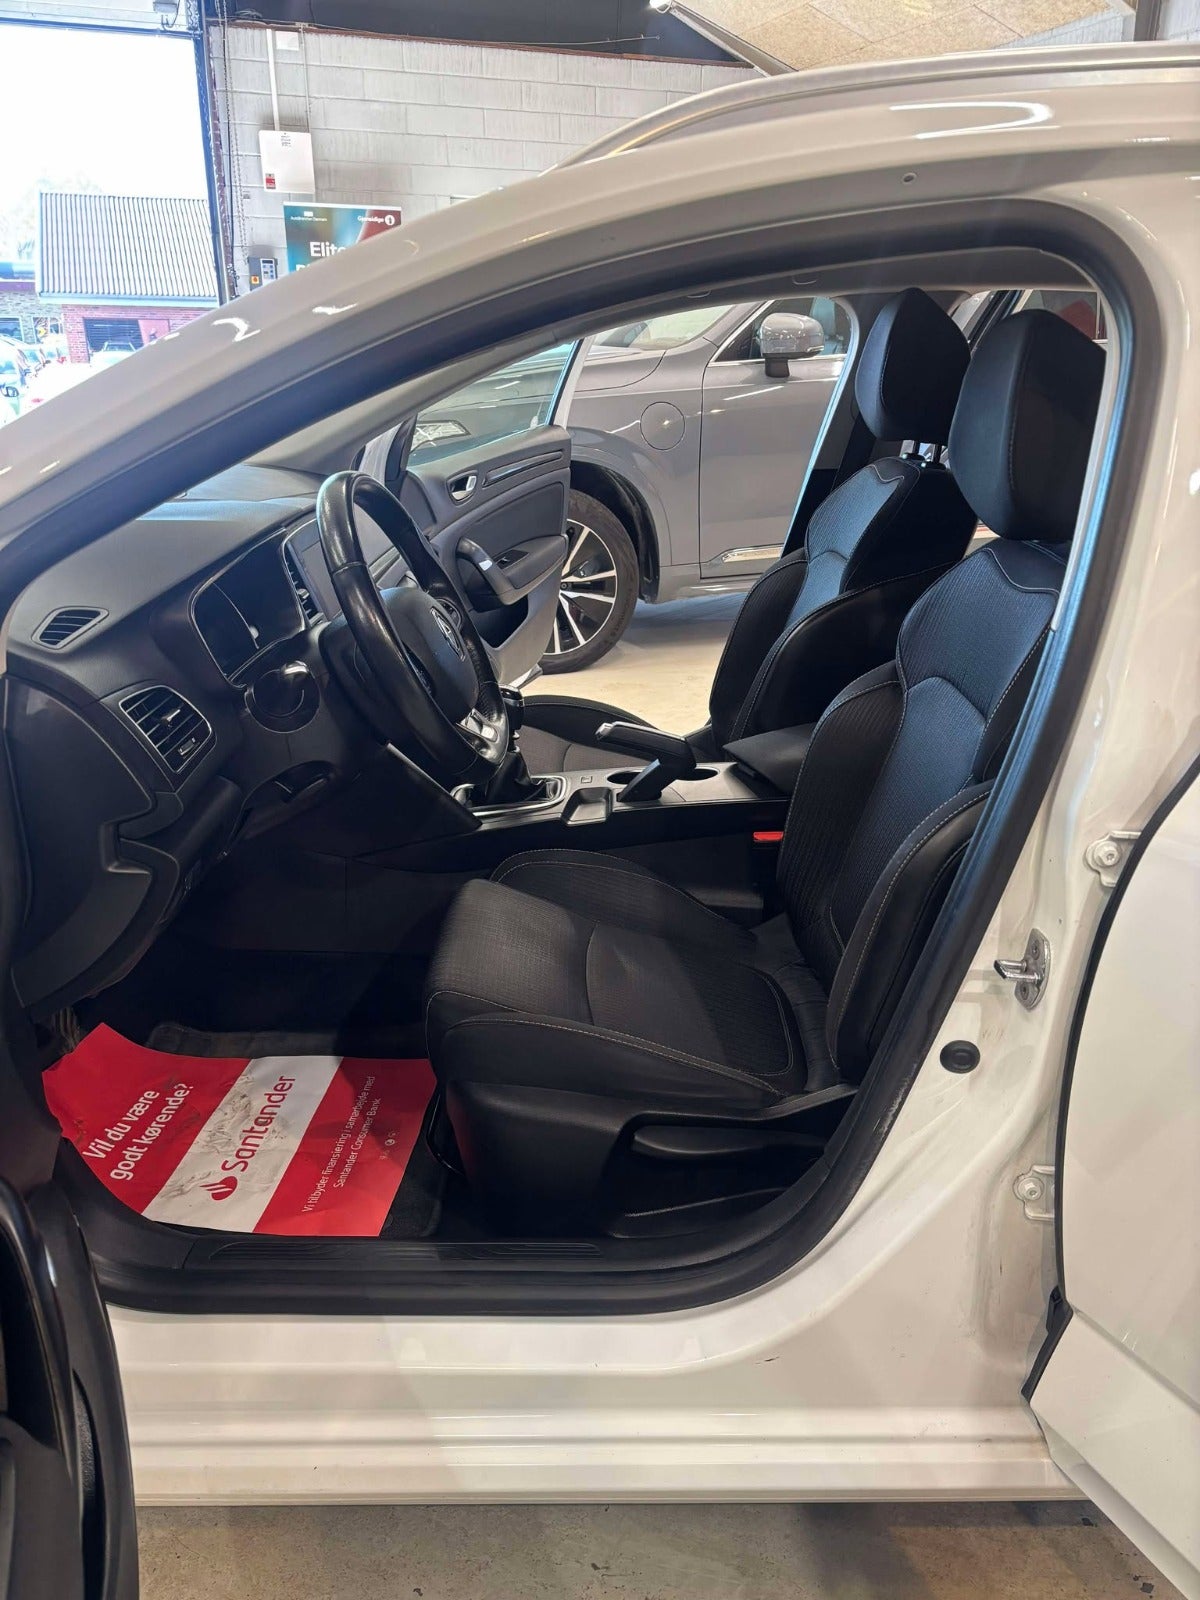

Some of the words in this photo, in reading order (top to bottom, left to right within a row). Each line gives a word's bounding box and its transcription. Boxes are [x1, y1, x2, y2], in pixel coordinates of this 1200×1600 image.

[363, 1076, 375, 1091] med
[82, 1138, 116, 1159] Vil
[104, 1122, 132, 1141] du
[122, 1090, 160, 1121] være
[221, 1075, 296, 1172] Santander
[345, 1091, 369, 1129] samarbejde
[110, 1145, 148, 1180] godt
[132, 1083, 193, 1145] kørende?
[333, 1150, 359, 1188] Santander
[350, 1117, 373, 1150] Consumer
[366, 1098, 381, 1116] Bank
[321, 1133, 352, 1175] finansiering
[301, 1204, 315, 1212] Vi
[307, 1175, 329, 1203] tilbyder
